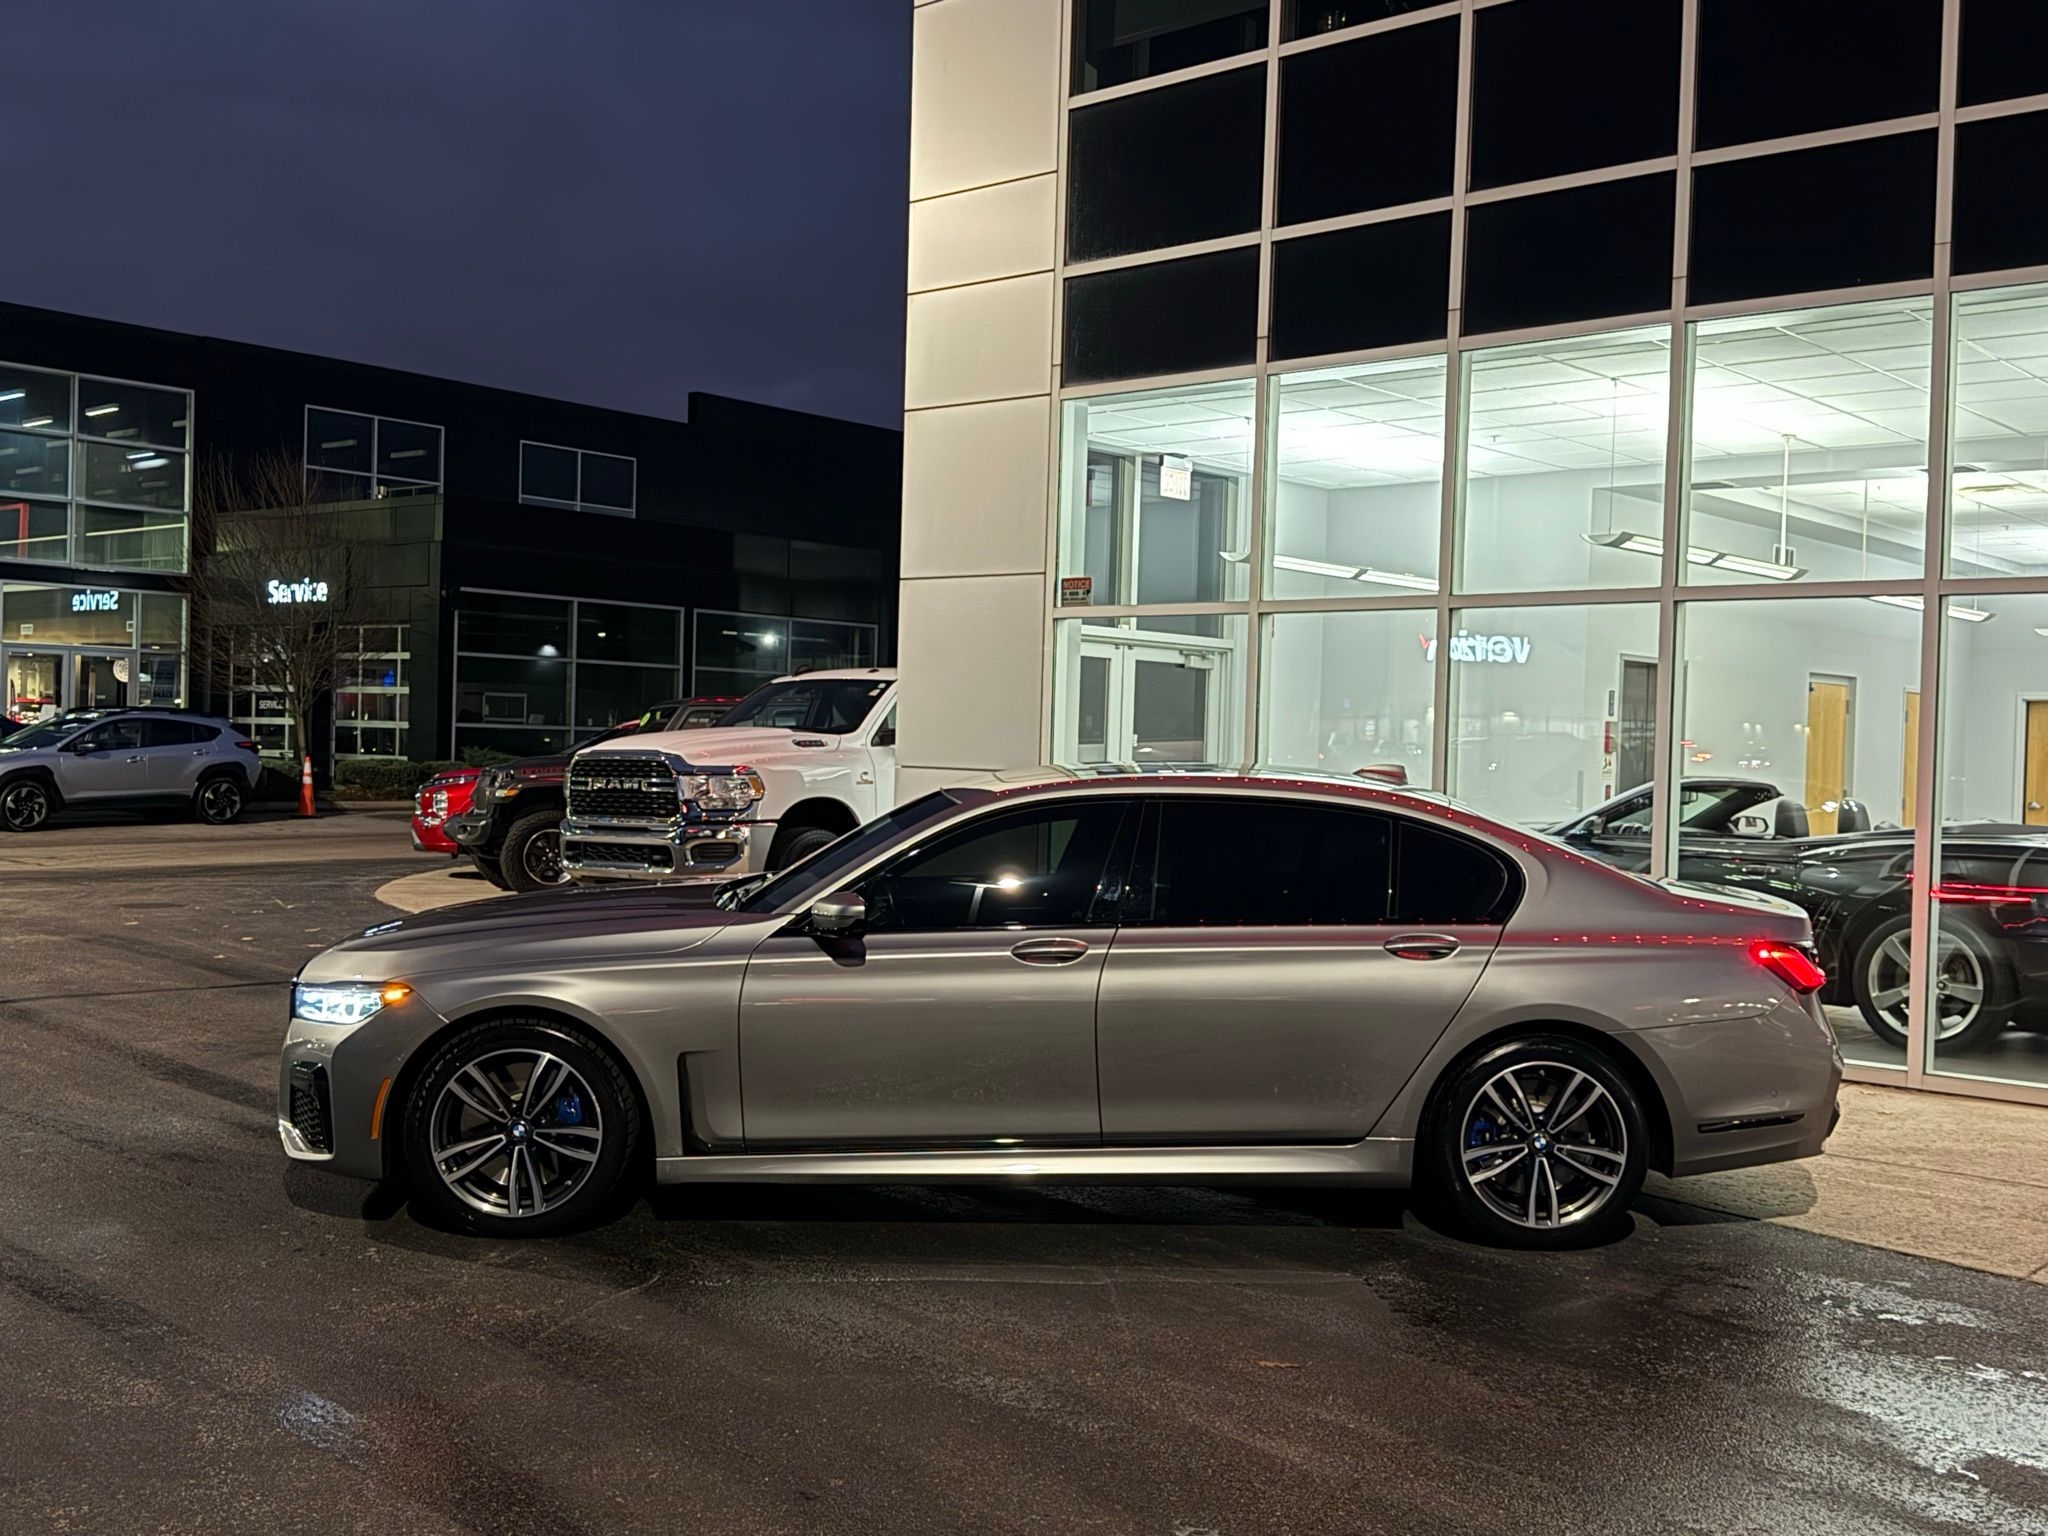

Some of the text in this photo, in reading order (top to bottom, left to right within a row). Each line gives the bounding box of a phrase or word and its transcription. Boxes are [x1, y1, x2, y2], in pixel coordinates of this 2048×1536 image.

[1063, 579, 1091, 589] NOTICE
[268, 577, 328, 604] Service
[593, 778, 639, 790] RAM
